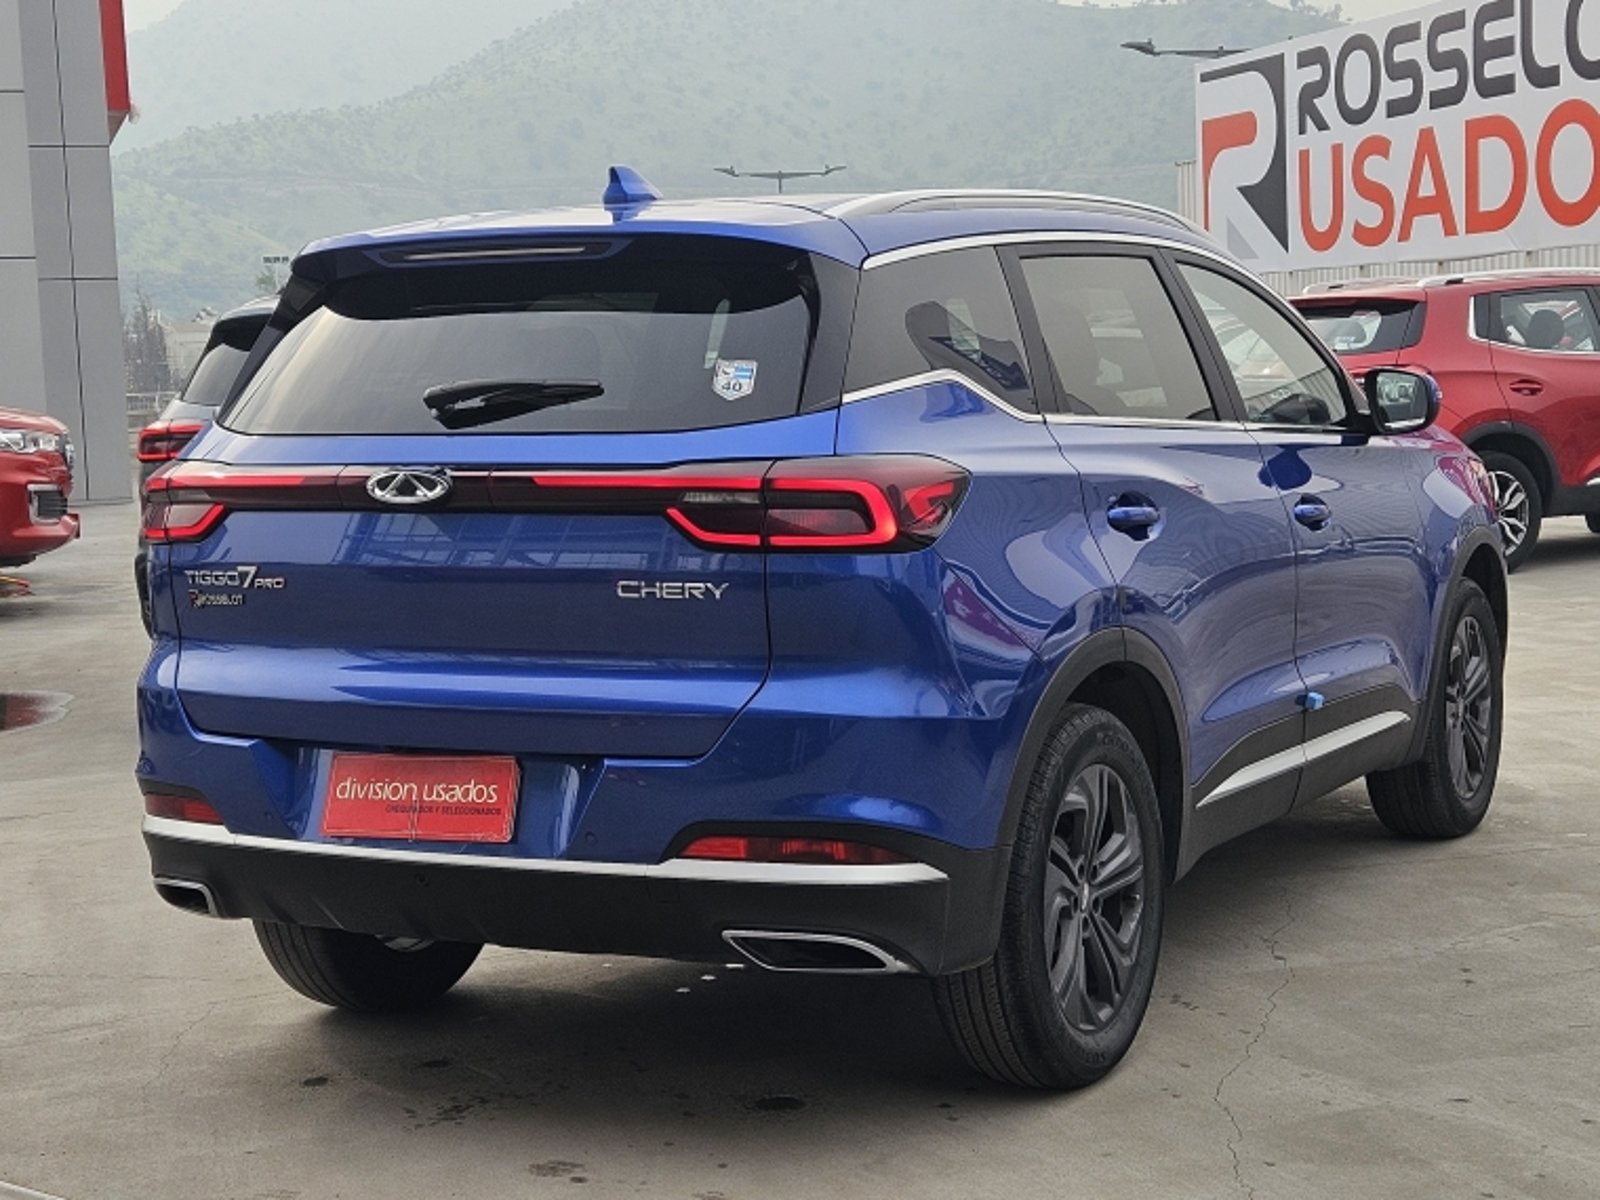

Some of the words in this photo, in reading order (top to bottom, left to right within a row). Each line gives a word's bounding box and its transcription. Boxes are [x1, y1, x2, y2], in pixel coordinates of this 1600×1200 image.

[1298, 98, 1600, 253] USADO
[184, 570, 240, 586] TIGGO
[236, 565, 257, 588] 7
[254, 578, 285, 588] PRO
[617, 580, 729, 599] CHERY
[423, 779, 498, 803] usados
